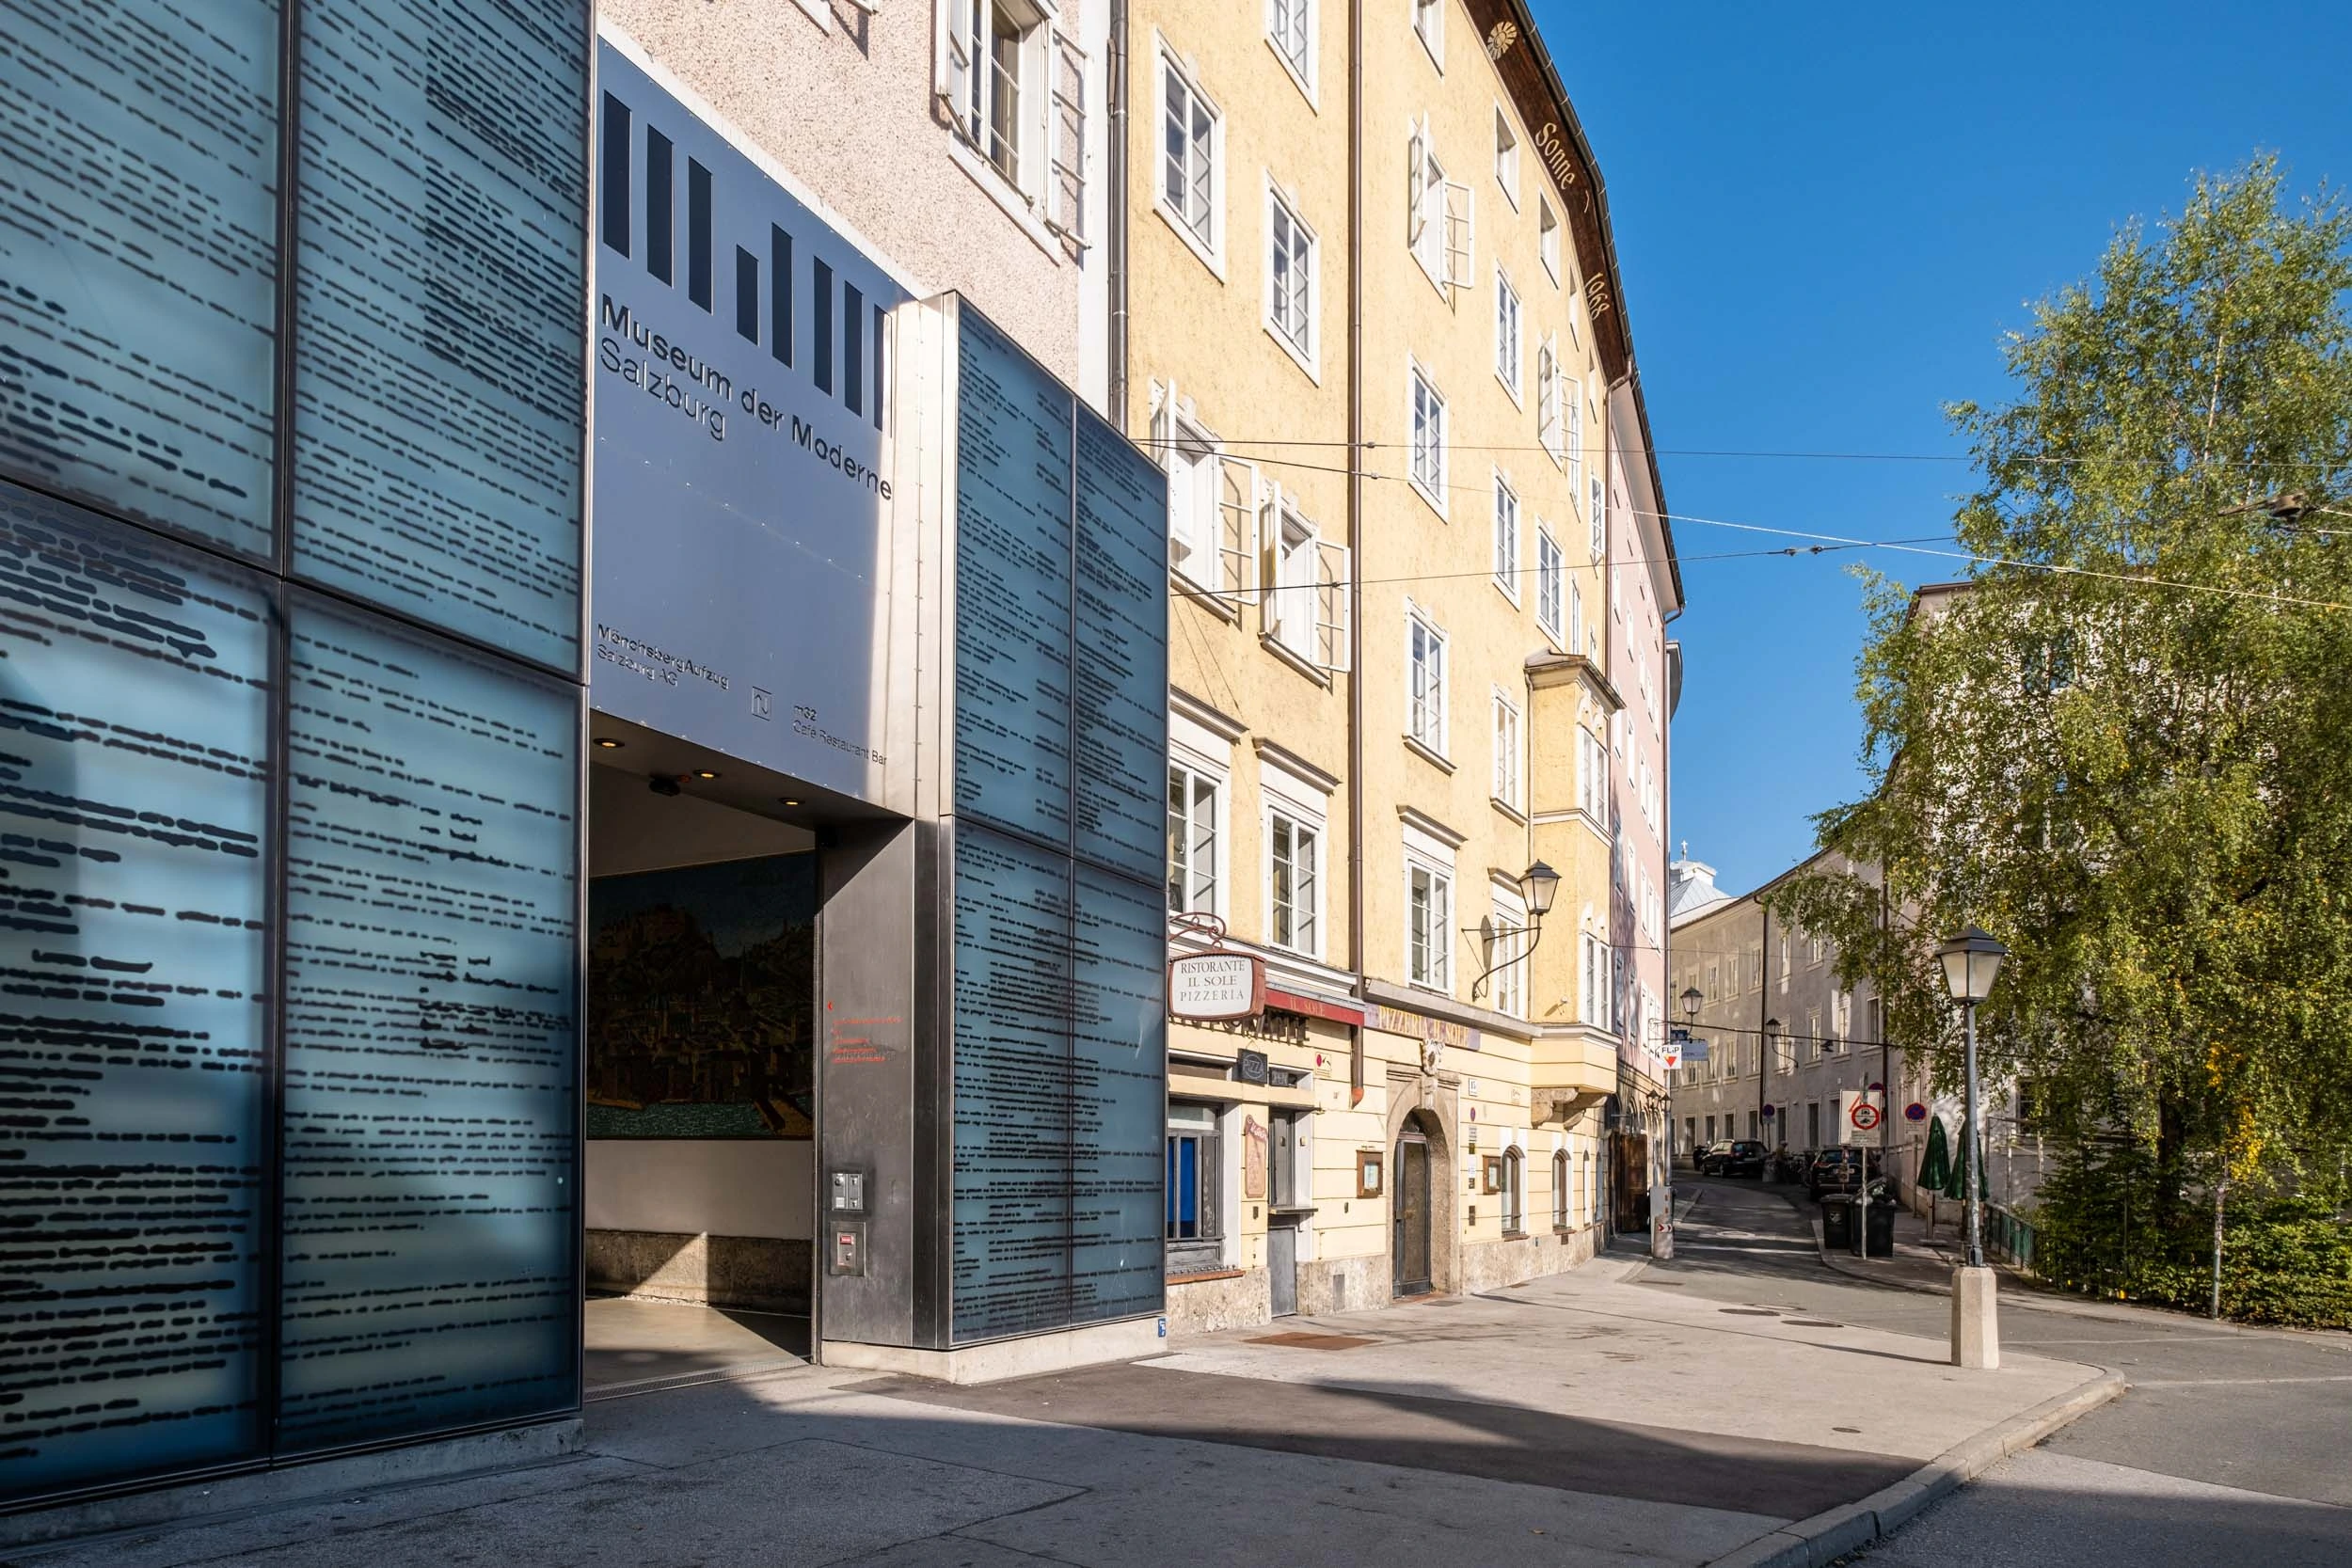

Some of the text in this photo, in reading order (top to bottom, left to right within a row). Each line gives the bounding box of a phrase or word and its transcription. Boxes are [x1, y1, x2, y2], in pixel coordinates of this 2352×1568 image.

[1535, 123, 1575, 190] Sonne
[1585, 272, 1610, 321] 1968
[600, 337, 726, 441] Salzburg
[602, 293, 892, 500] Museum der Moderne
[660, 668, 677, 687] AG
[871, 750, 887, 765] Bar
[1181, 959, 1246, 974] RISTORANTE
[1188, 974, 1237, 987] IL SOLE
[1180, 990, 1244, 1001] PIZZERIA
[1378, 1005, 1428, 1039] PIZZERIA
[1445, 1022, 1470, 1047] SOLE
